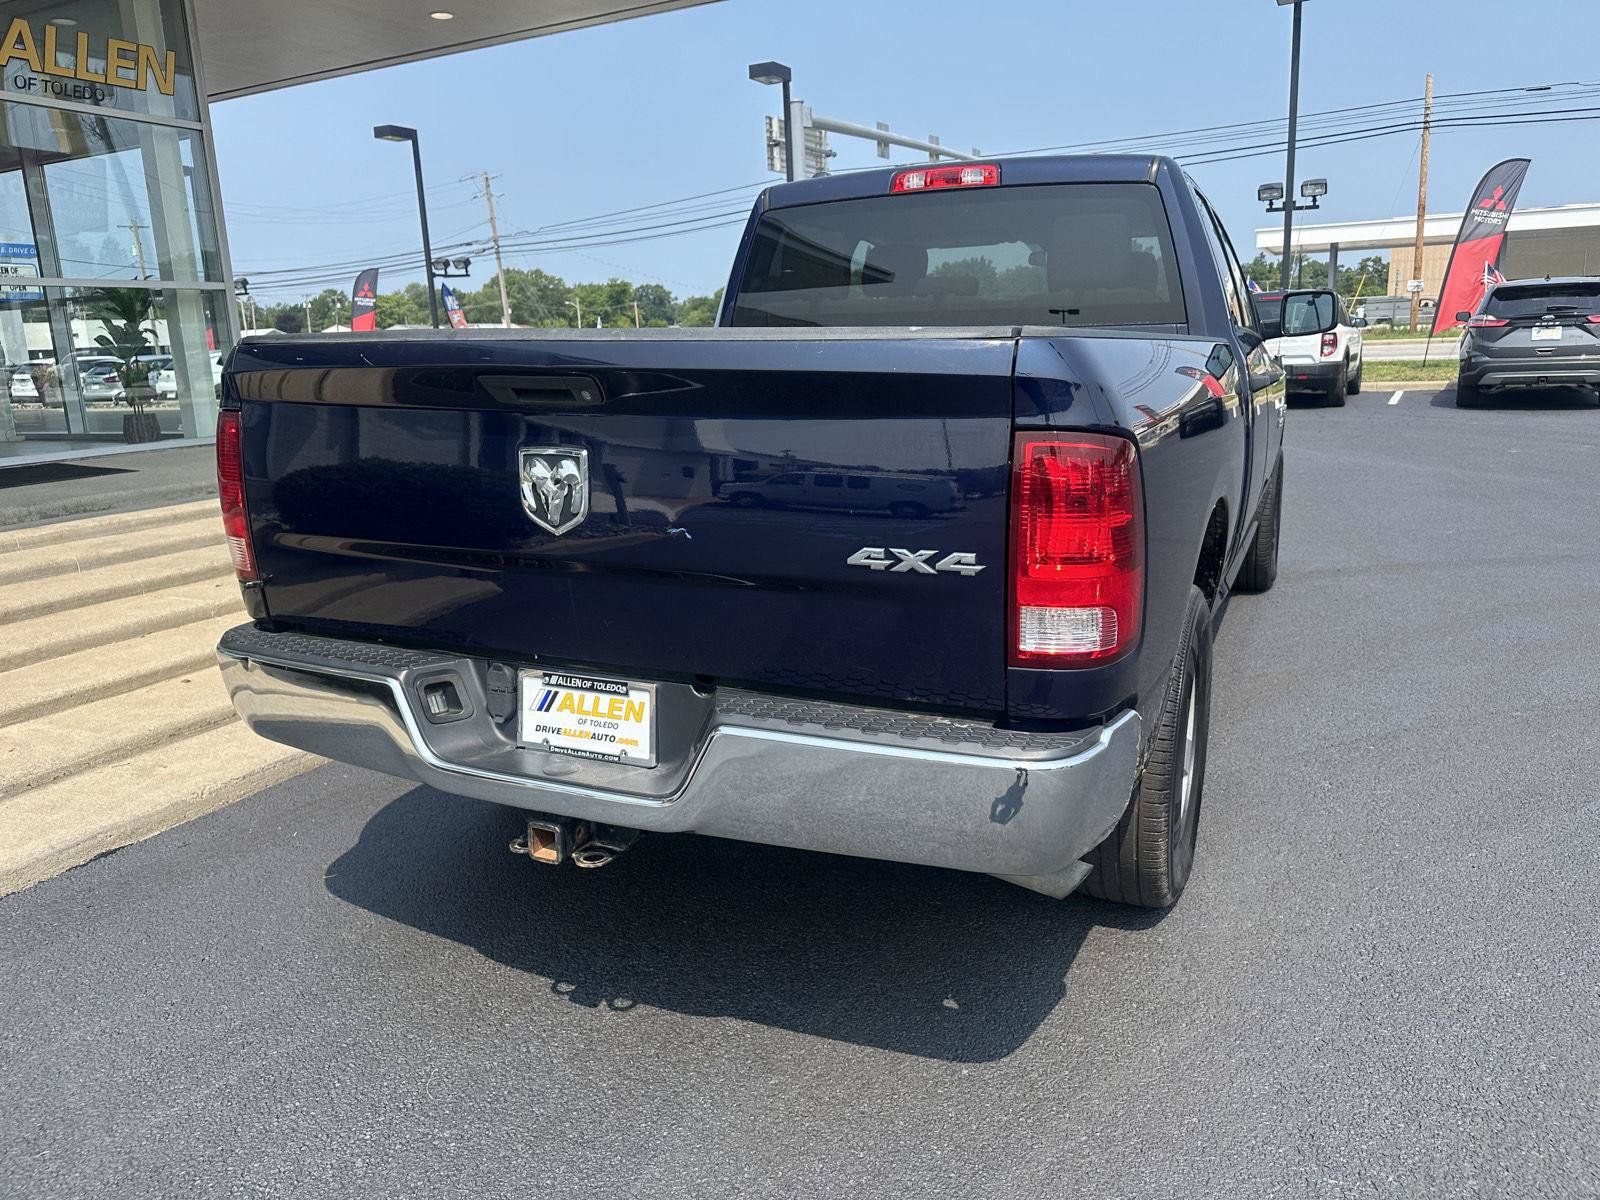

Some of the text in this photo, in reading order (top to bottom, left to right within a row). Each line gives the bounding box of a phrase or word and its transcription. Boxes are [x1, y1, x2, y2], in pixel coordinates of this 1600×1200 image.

[0, 17, 176, 96] ALLEN
[14, 74, 105, 102] OF TOLEDO
[1471, 209, 1509, 219] MITSUBISHI
[1474, 216, 1502, 224] MOTORS
[847, 547, 987, 576] 4X4
[557, 676, 622, 693] ALLEN OF TOLEDO
[556, 692, 645, 722] ALLEN
[577, 717, 619, 730] OF TOLEDO
